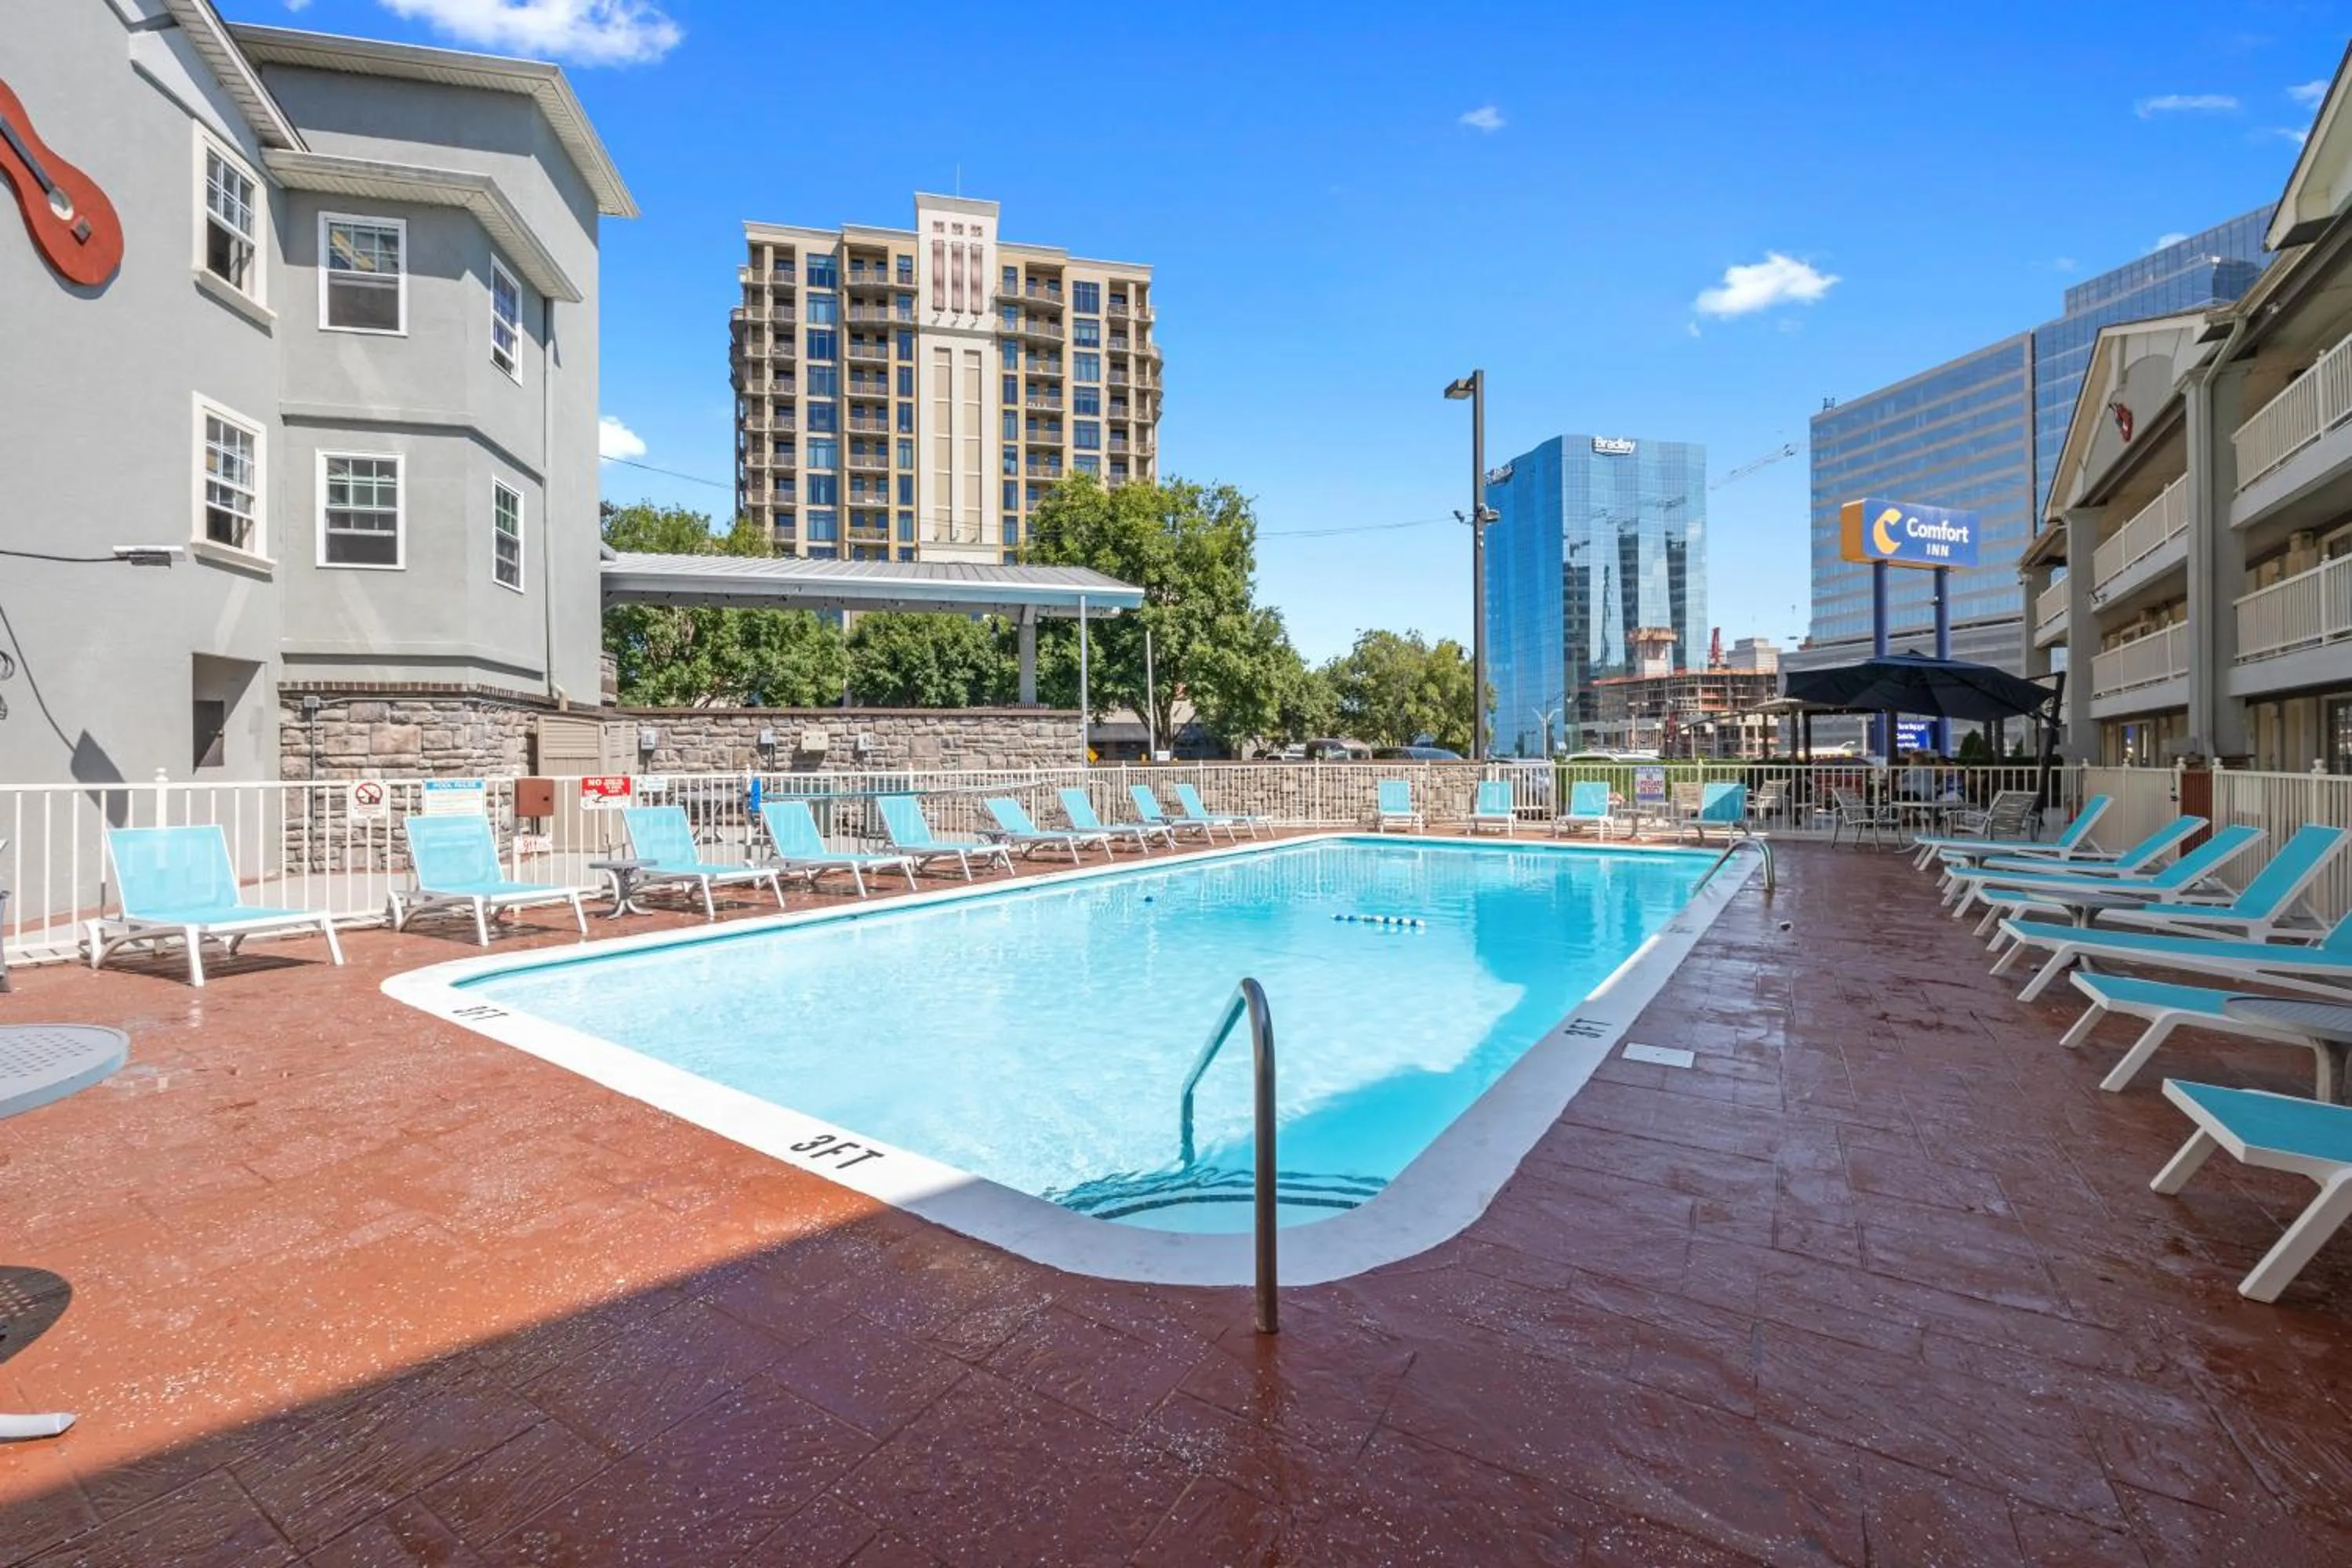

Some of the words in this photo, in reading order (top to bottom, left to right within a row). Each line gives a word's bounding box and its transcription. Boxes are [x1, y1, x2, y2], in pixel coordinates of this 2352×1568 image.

[1907, 517, 1969, 543] Comfort
[1926, 543, 1950, 557] INN
[587, 778, 603, 786] NO
[452, 1006, 510, 1021] 3FT
[790, 1134, 885, 1169] 3FT
